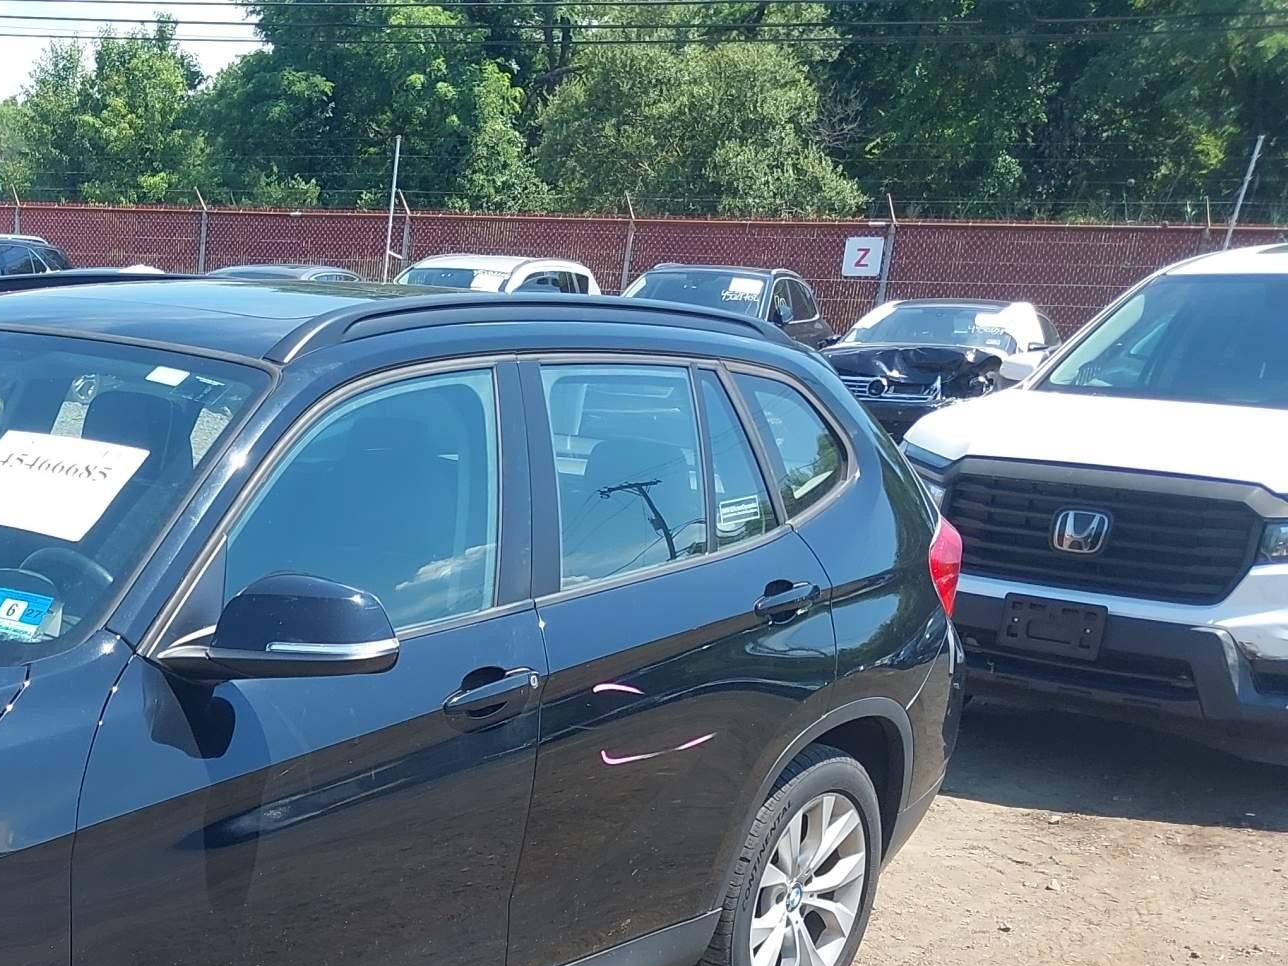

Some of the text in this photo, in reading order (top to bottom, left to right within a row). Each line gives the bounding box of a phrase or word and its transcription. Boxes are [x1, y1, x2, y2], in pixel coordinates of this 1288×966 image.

[854, 247, 871, 268] Z
[0, 452, 113, 481] 45466685
[6, 603, 19, 617] 6
[26, 608, 43, 618] 27
